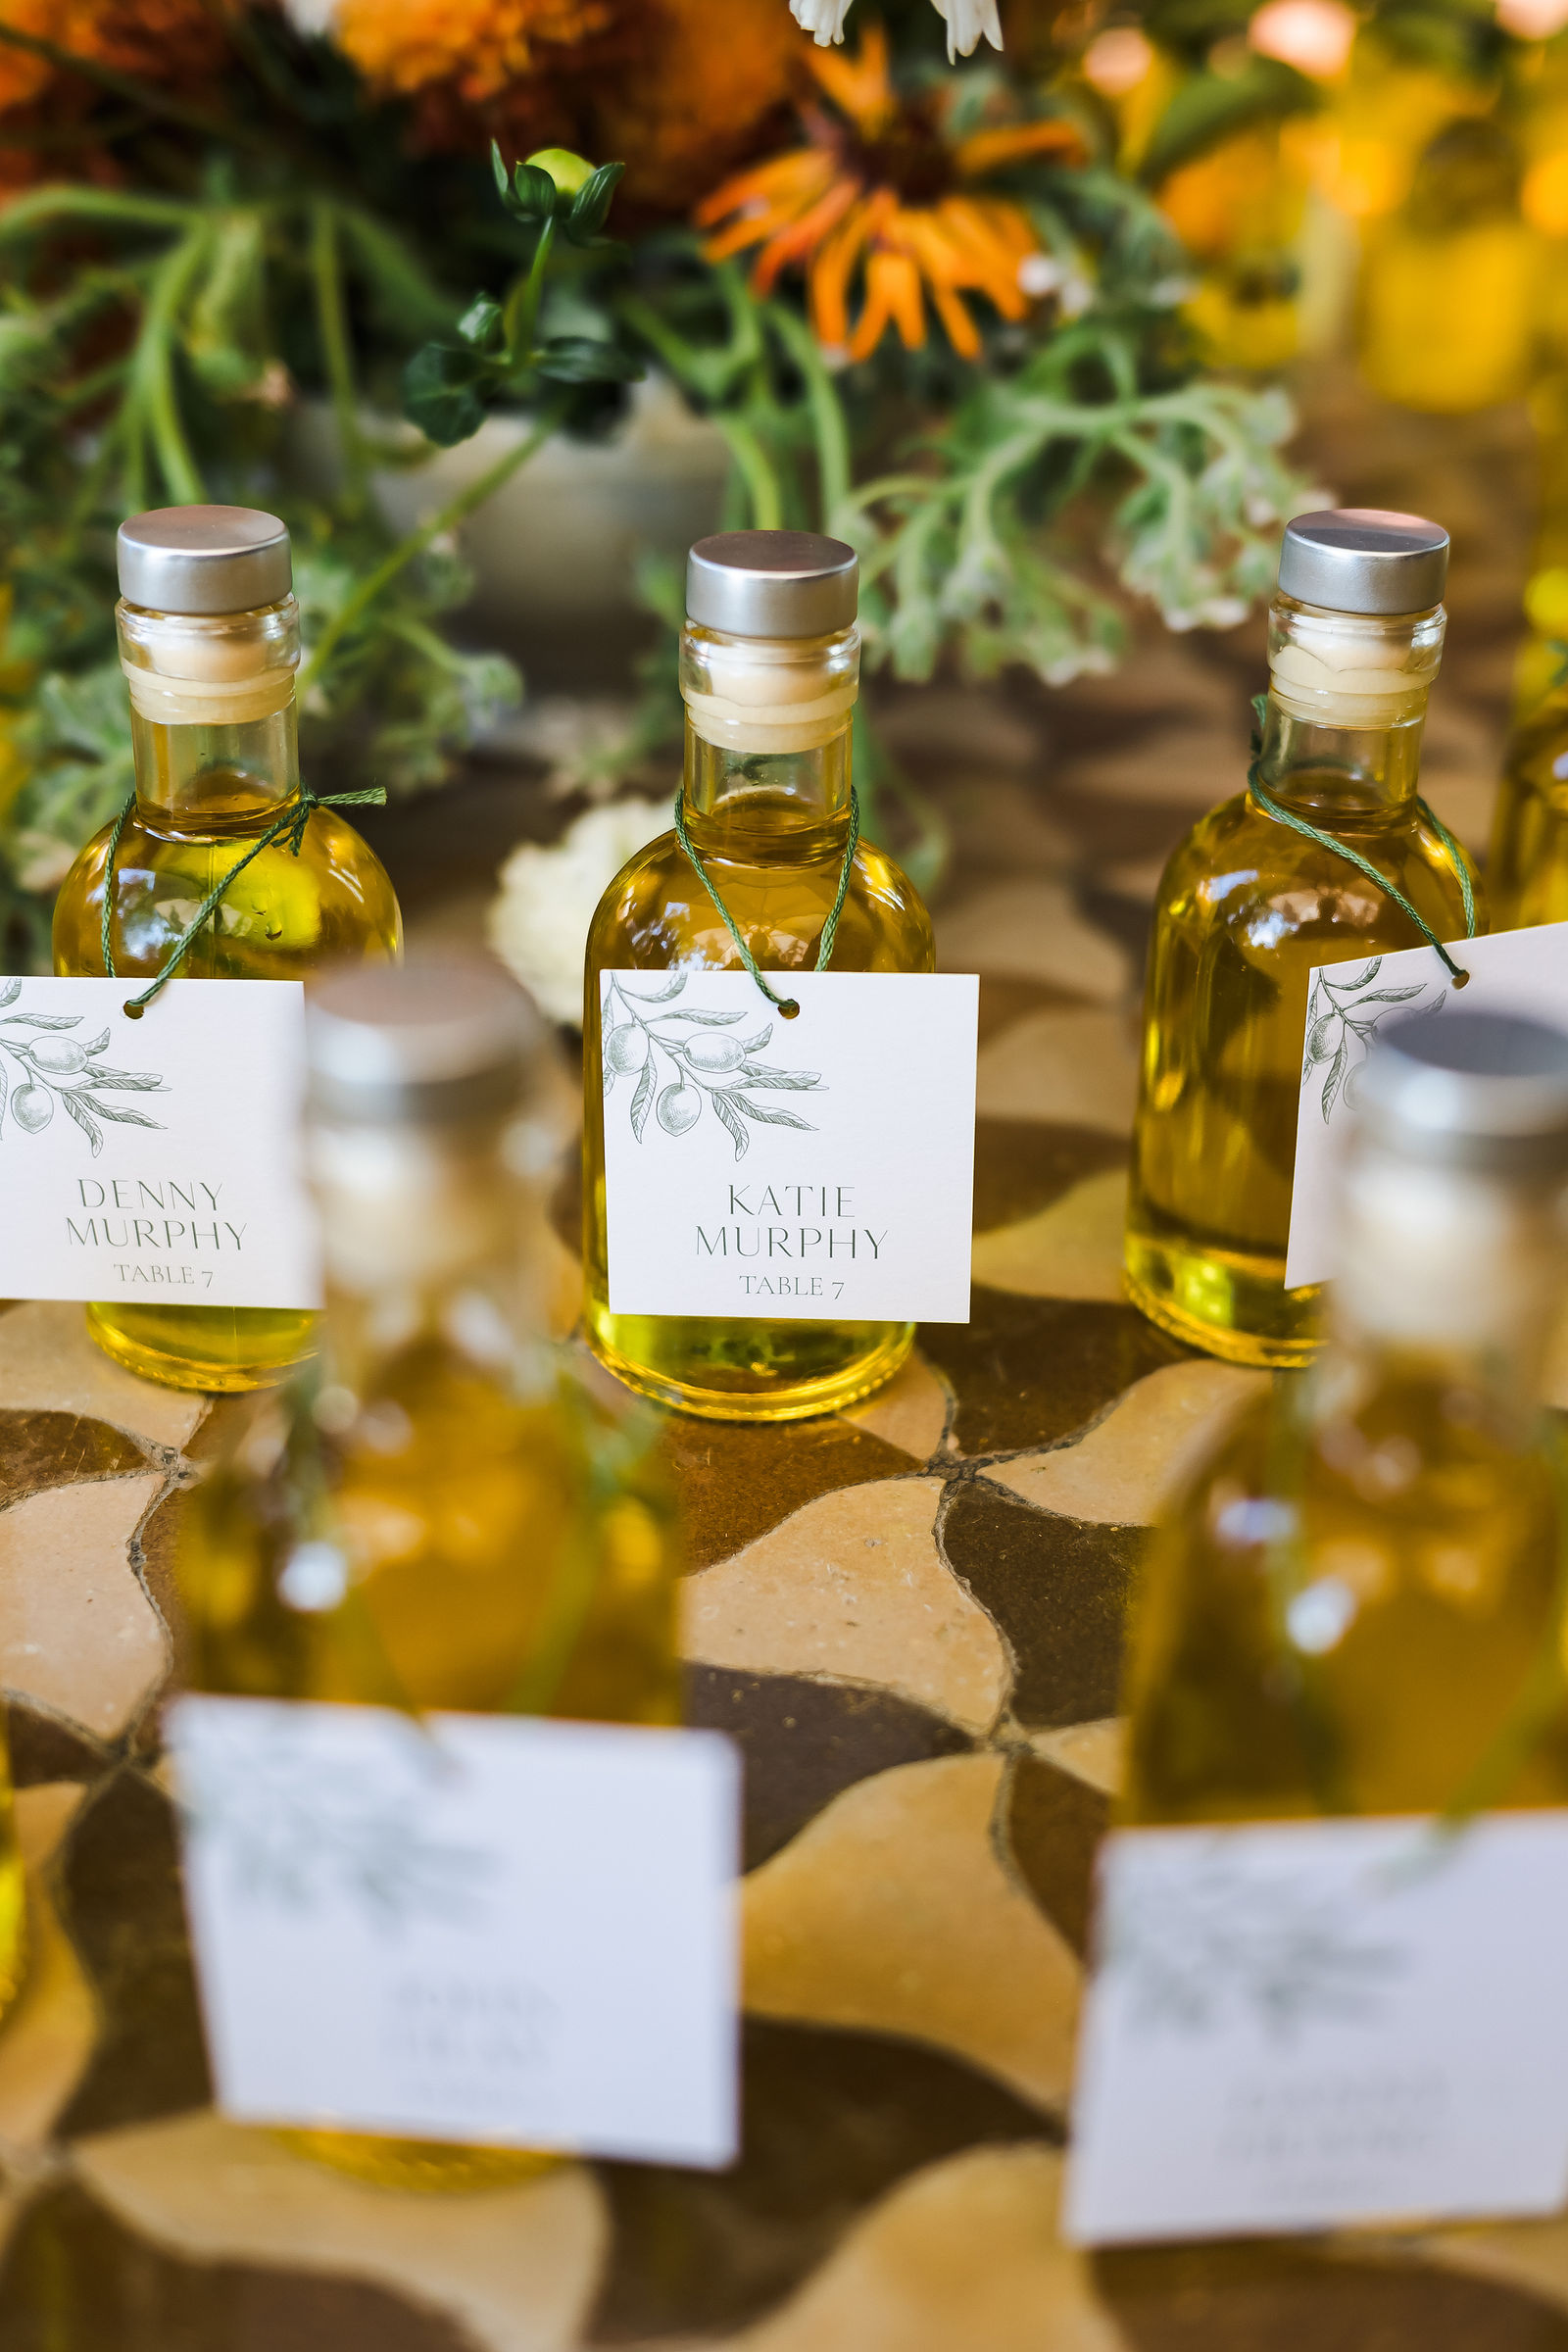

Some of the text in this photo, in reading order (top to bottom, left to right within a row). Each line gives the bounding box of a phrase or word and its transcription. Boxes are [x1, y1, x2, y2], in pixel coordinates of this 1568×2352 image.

[77, 1178, 223, 1211] DENNY
[728, 1184, 856, 1218] KATIE
[66, 1216, 247, 1251] MURPHY
[696, 1225, 889, 1259] MURPHY
[113, 1263, 214, 1289] TABLE 7
[739, 1275, 845, 1300] TABLE 7
